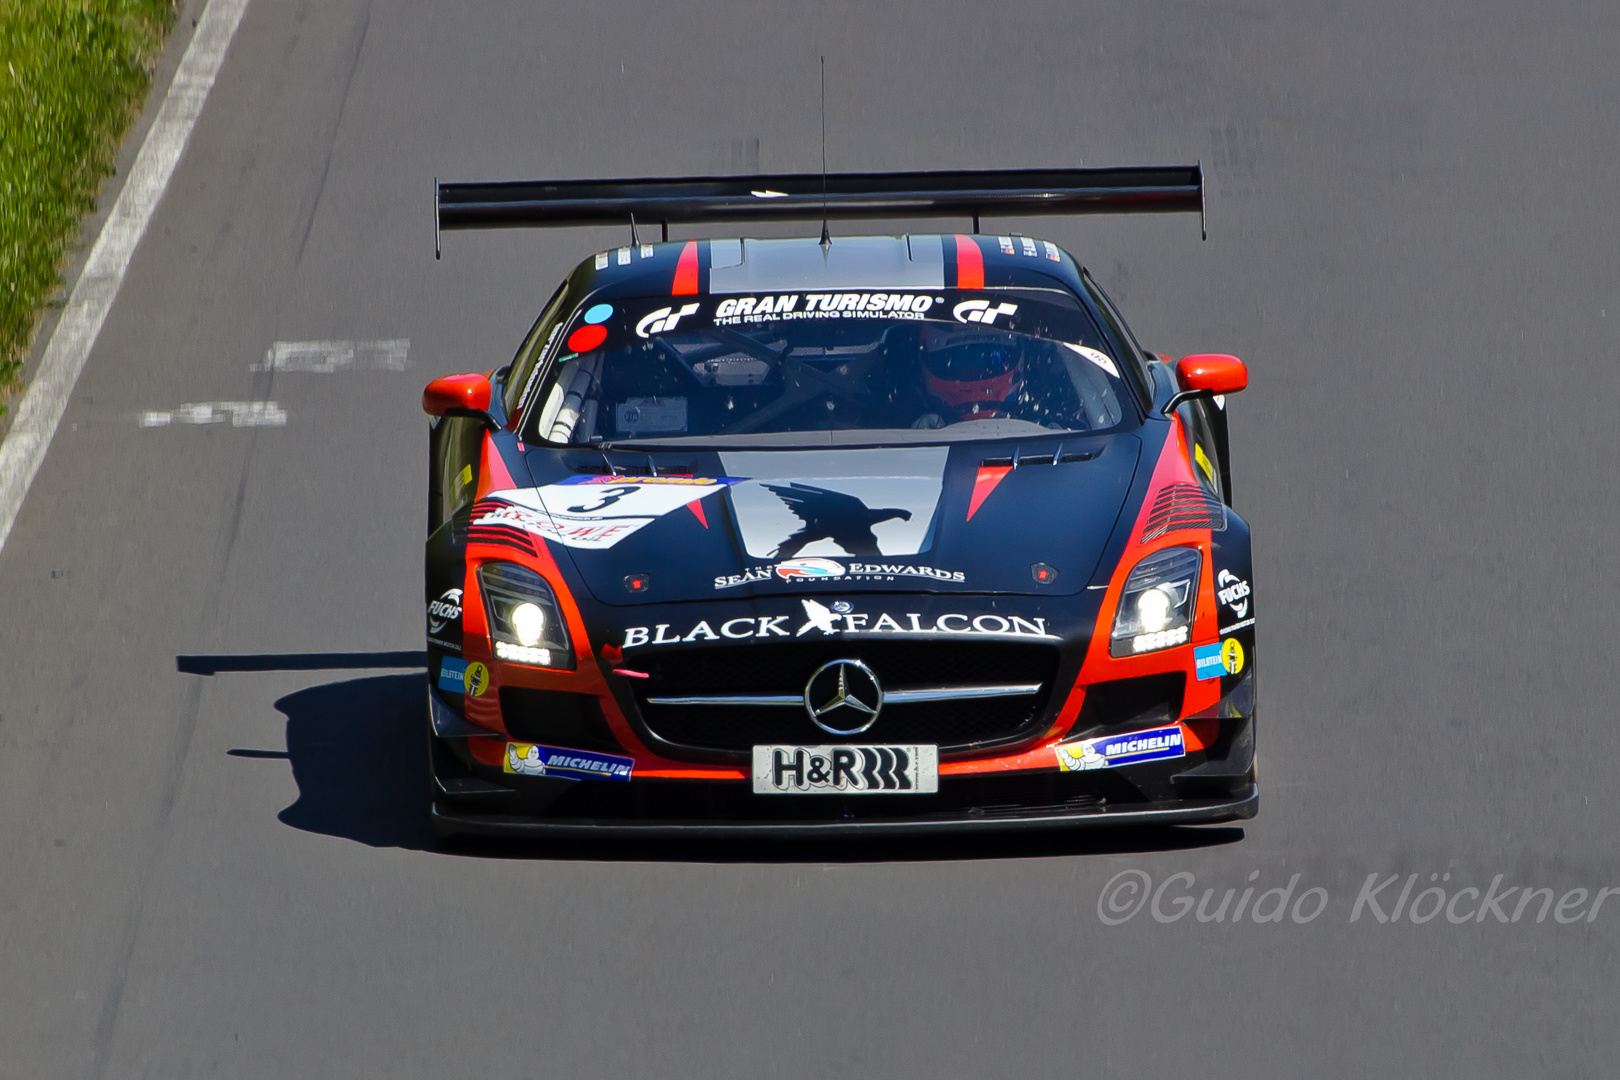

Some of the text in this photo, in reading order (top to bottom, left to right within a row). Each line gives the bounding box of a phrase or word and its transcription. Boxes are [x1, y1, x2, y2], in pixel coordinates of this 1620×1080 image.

[716, 295, 798, 317] GRAN
[713, 311, 925, 326] THE REAL DRIVING SIMULATOR
[566, 486, 641, 513] 3
[786, 575, 894, 584] FOUNDATION
[849, 563, 965, 581] EDWARDS
[1218, 581, 1251, 605] FUCHS
[427, 600, 462, 619] FUCHS
[623, 613, 1048, 649] BLACK FALCON
[1196, 654, 1222, 668] BILSTEIN
[441, 668, 464, 681] BILSTEIN
[1105, 733, 1181, 756] MICHELIN
[547, 755, 631, 775] MICHELIN
